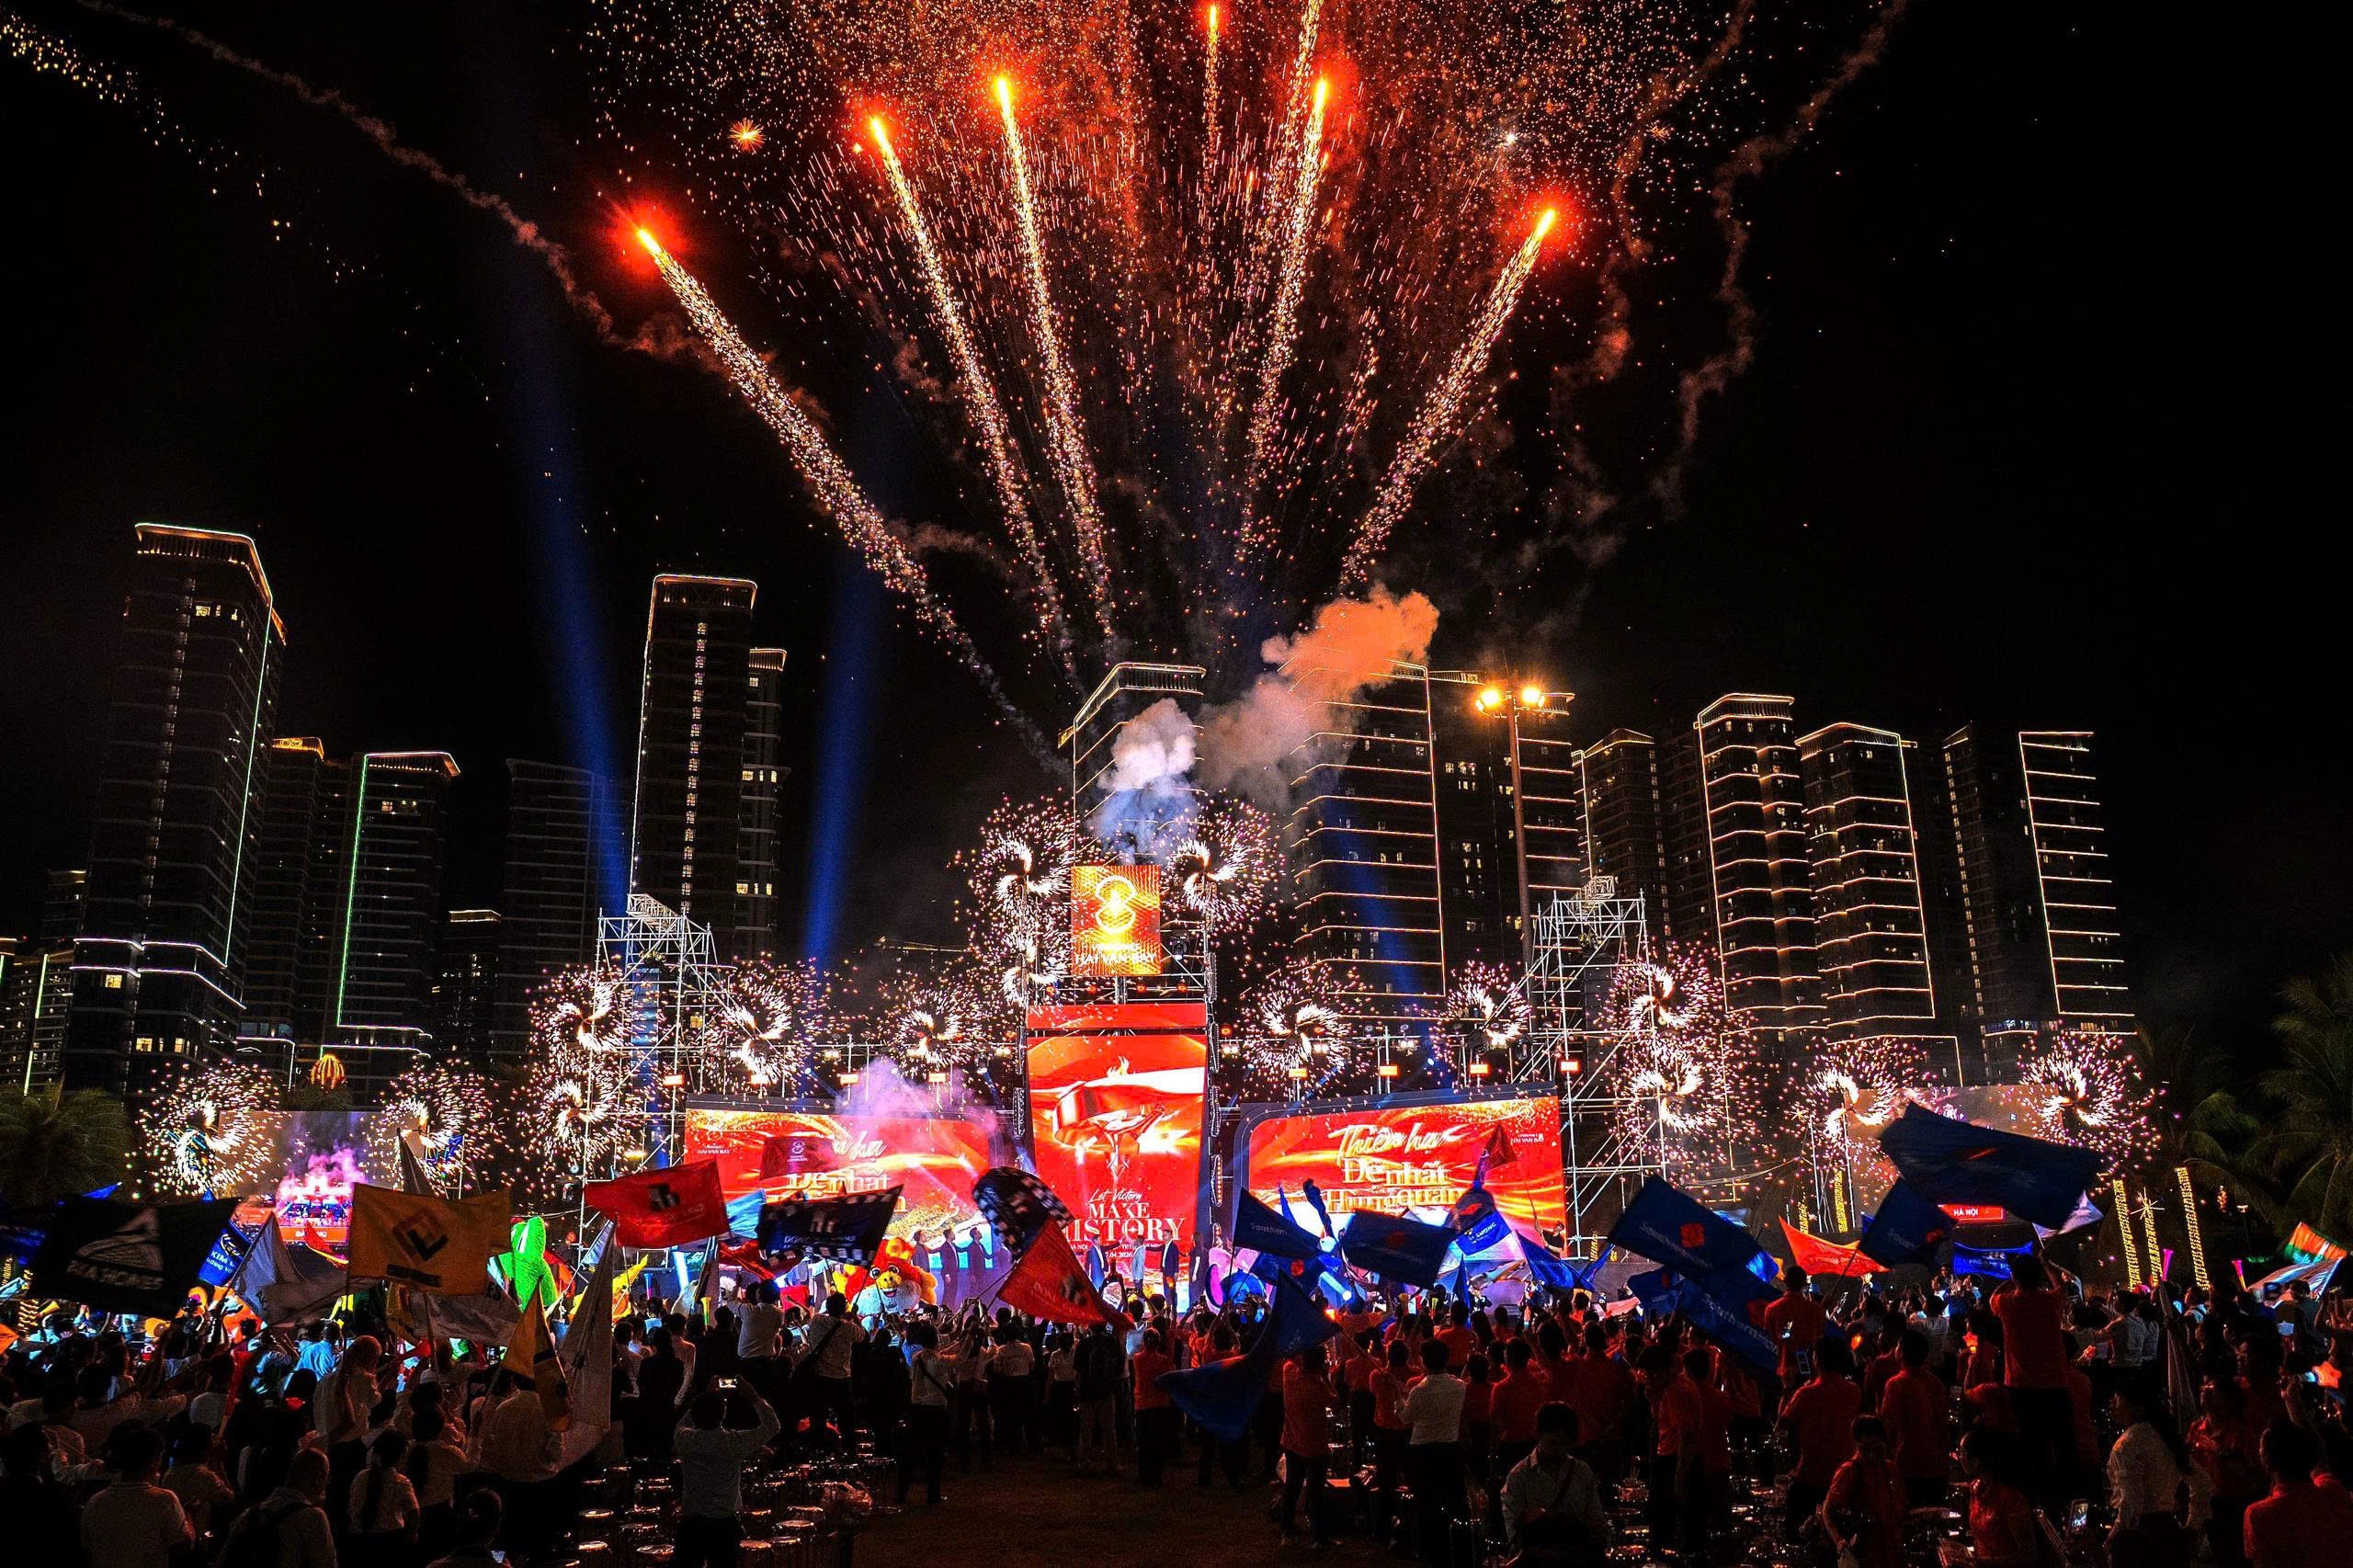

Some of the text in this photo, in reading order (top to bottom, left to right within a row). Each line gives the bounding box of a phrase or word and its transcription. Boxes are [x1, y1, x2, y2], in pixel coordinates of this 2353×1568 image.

[1088, 1188, 1143, 1203] Let Victory
[1089, 1202, 1149, 1219] MAKE
[210, 1250, 229, 1265] KIM
